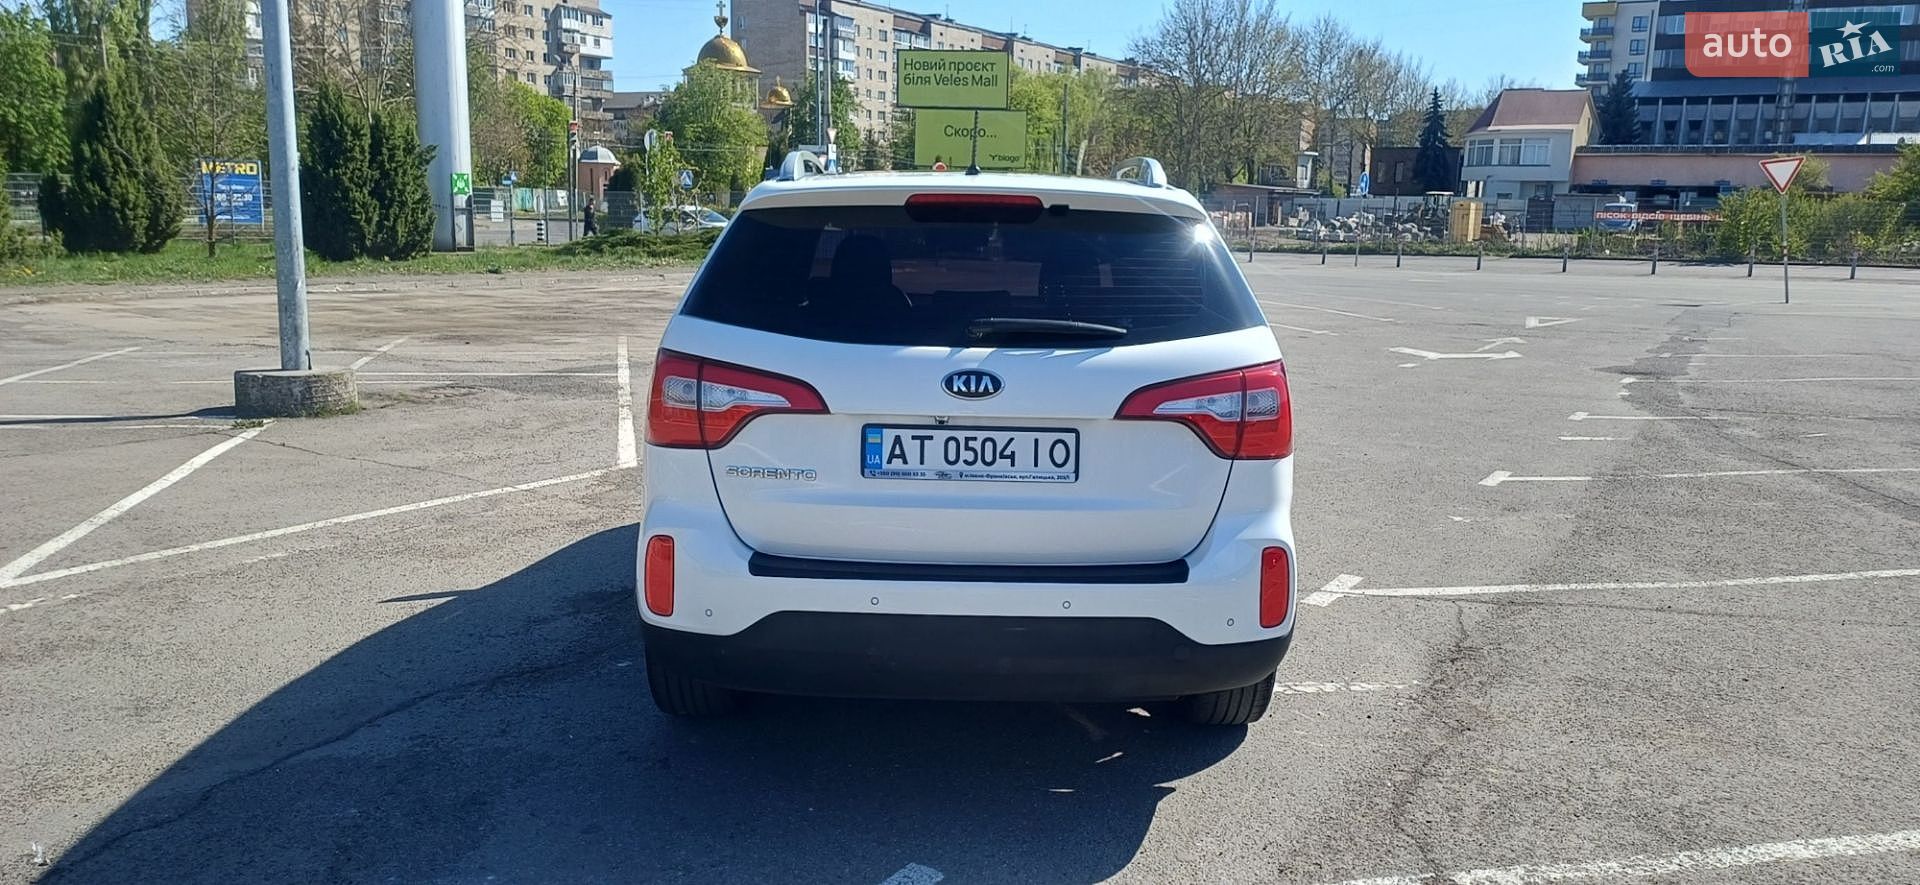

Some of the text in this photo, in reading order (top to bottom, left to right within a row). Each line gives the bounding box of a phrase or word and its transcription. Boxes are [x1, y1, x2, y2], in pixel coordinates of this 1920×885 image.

[903, 58, 997, 75] Новий проєкт
[903, 72, 998, 88] біля Veles Mall
[201, 161, 258, 175] METRO
[1596, 211, 1630, 220] ПІСОК
[952, 374, 995, 393] KIA
[866, 454, 881, 465] UA
[886, 434, 1071, 469] AT 0504 IO
[726, 465, 817, 482] SORENTO
